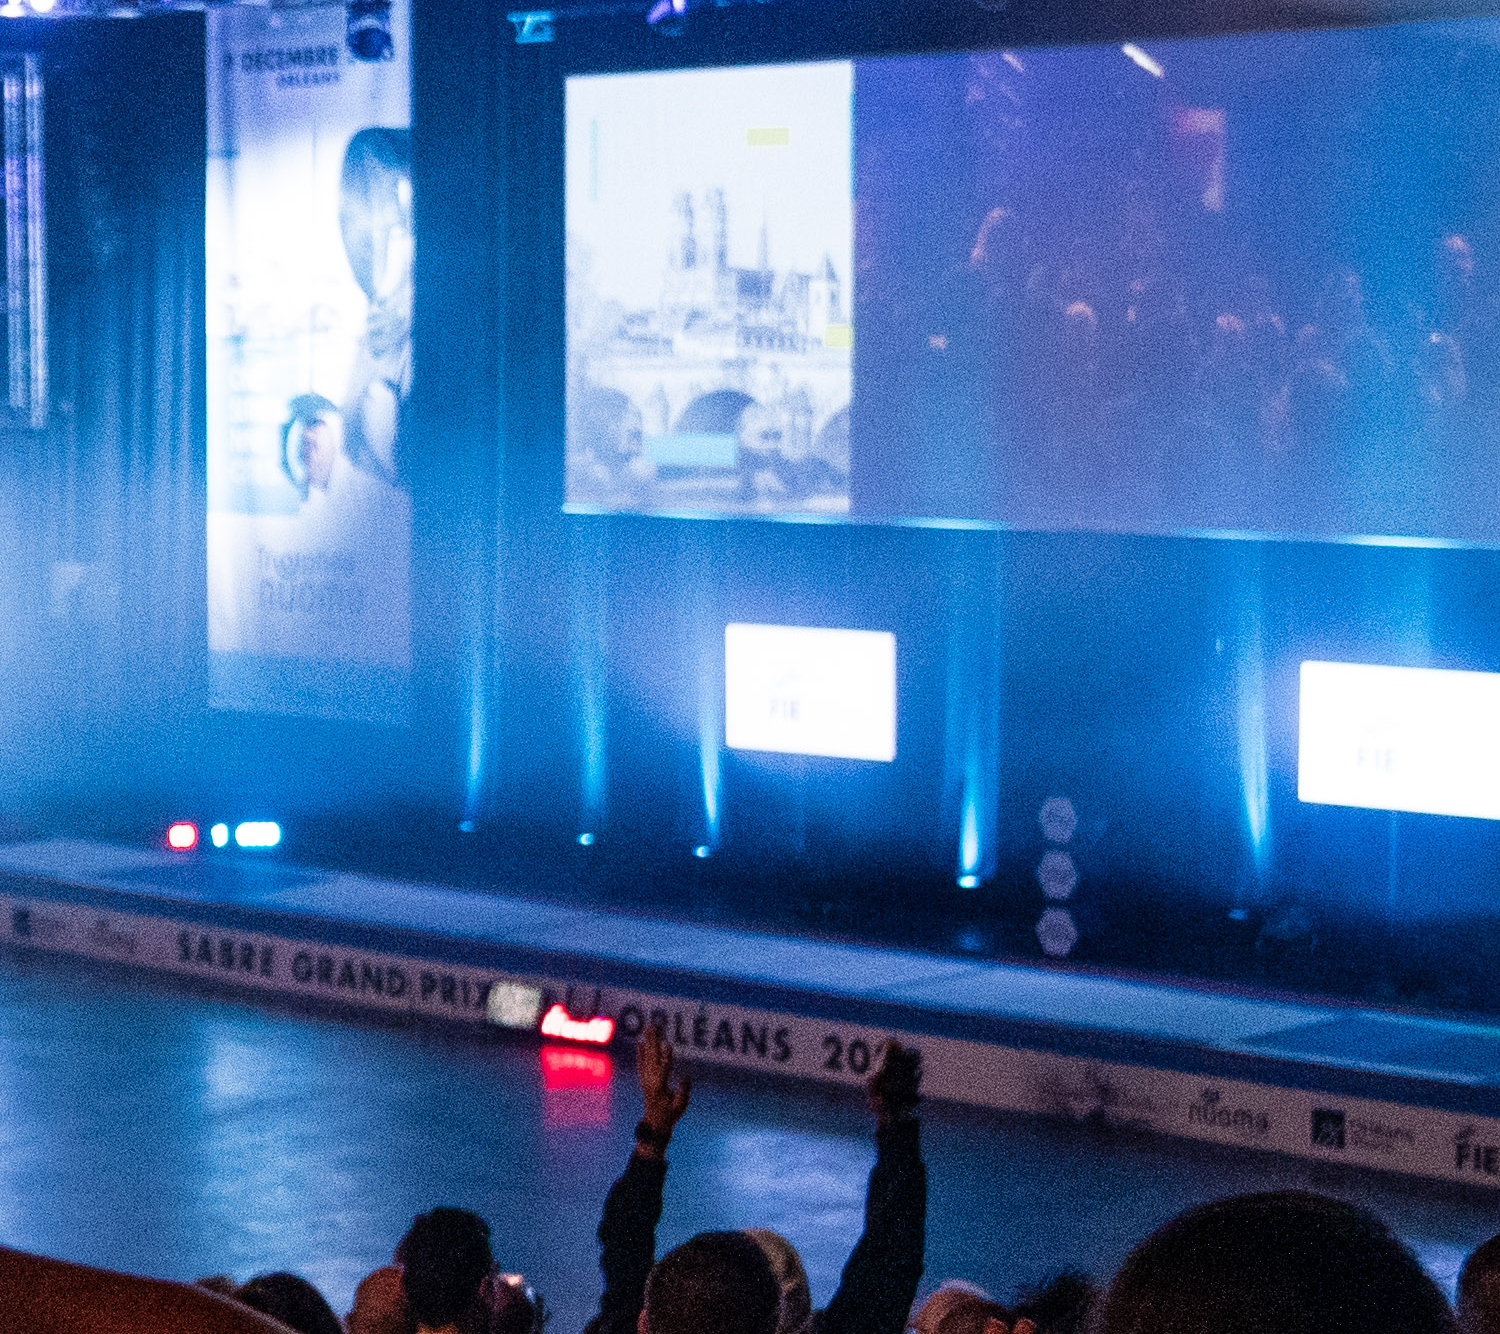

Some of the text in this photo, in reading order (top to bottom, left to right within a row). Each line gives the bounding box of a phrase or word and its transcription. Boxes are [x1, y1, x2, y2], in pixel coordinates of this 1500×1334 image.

[178, 930, 273, 978] SABRE
[291, 950, 407, 998] GRAND
[420, 972, 496, 1009] PRIX
[620, 1004, 792, 1063] ORLÉANS
[1456, 1142, 1500, 1175] FIE
